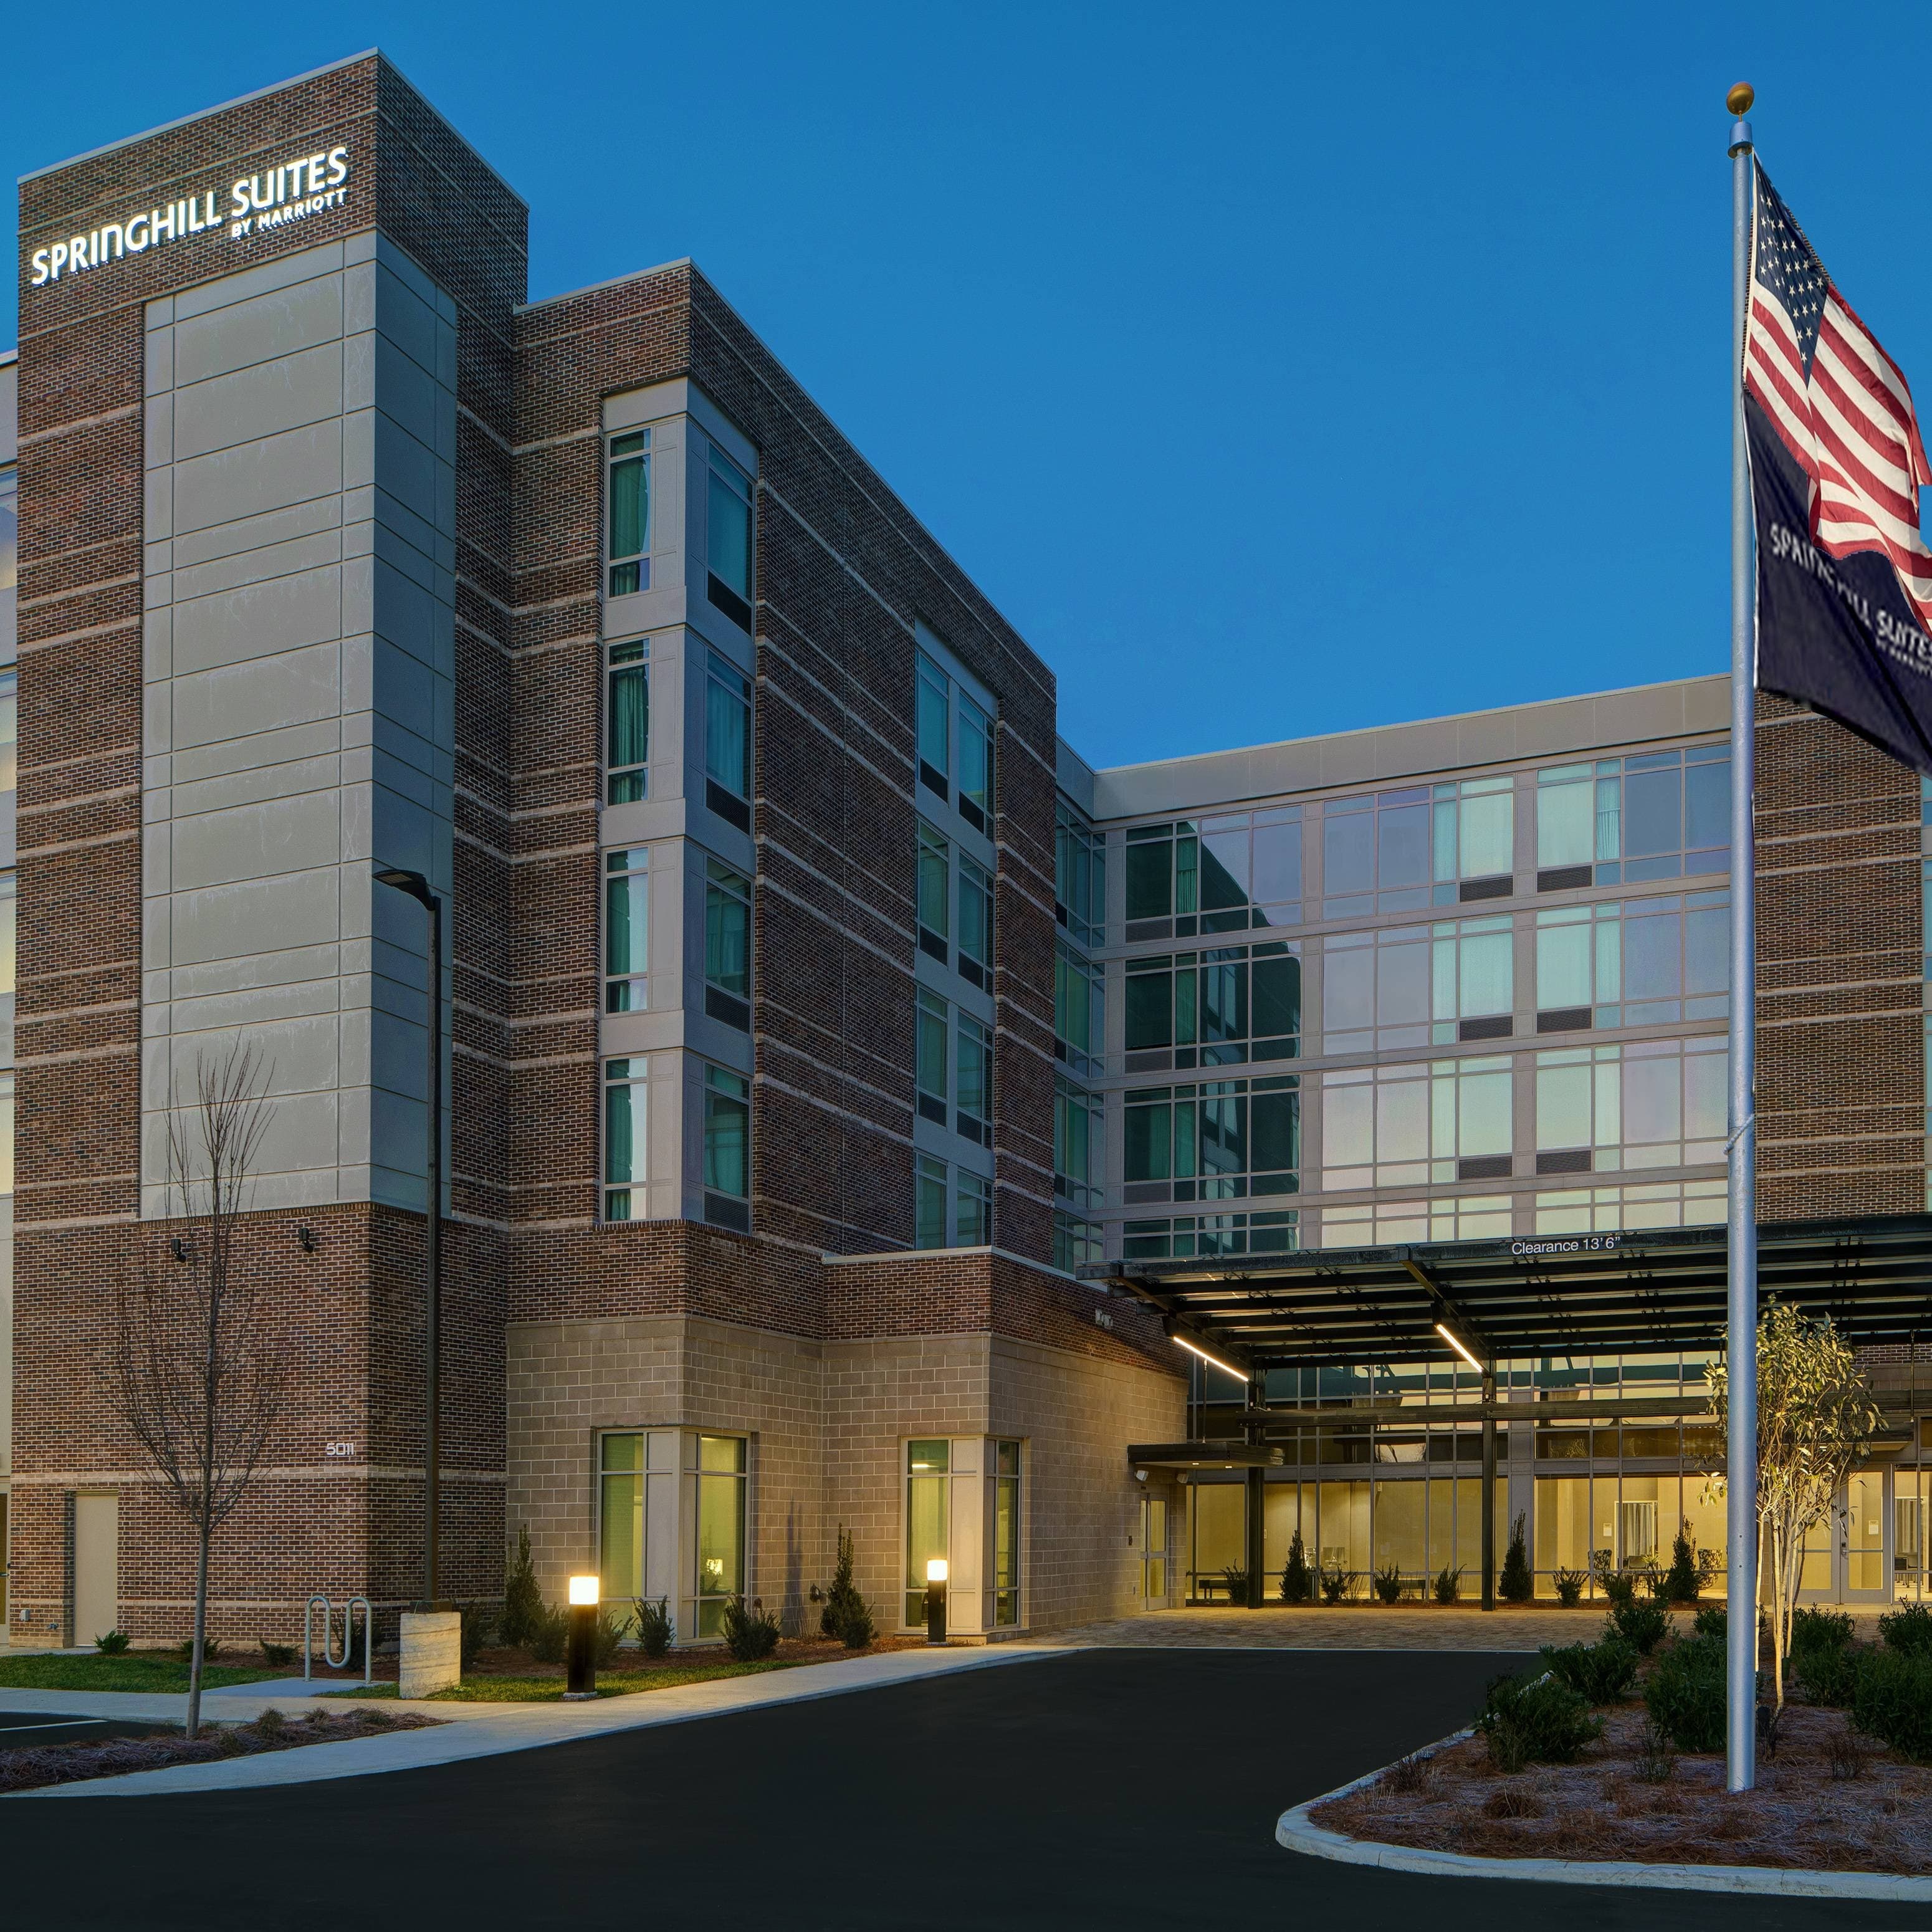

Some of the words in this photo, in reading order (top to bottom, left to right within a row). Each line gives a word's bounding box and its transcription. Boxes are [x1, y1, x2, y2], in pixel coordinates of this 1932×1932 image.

[31, 191, 222, 286] SPRINGHILL
[231, 146, 348, 218] SUITES
[232, 218, 252, 238] BY
[258, 188, 347, 230] MARRIOTT
[1512, 1241, 1579, 1255] Clearance
[327, 1442, 354, 1455] 5011
